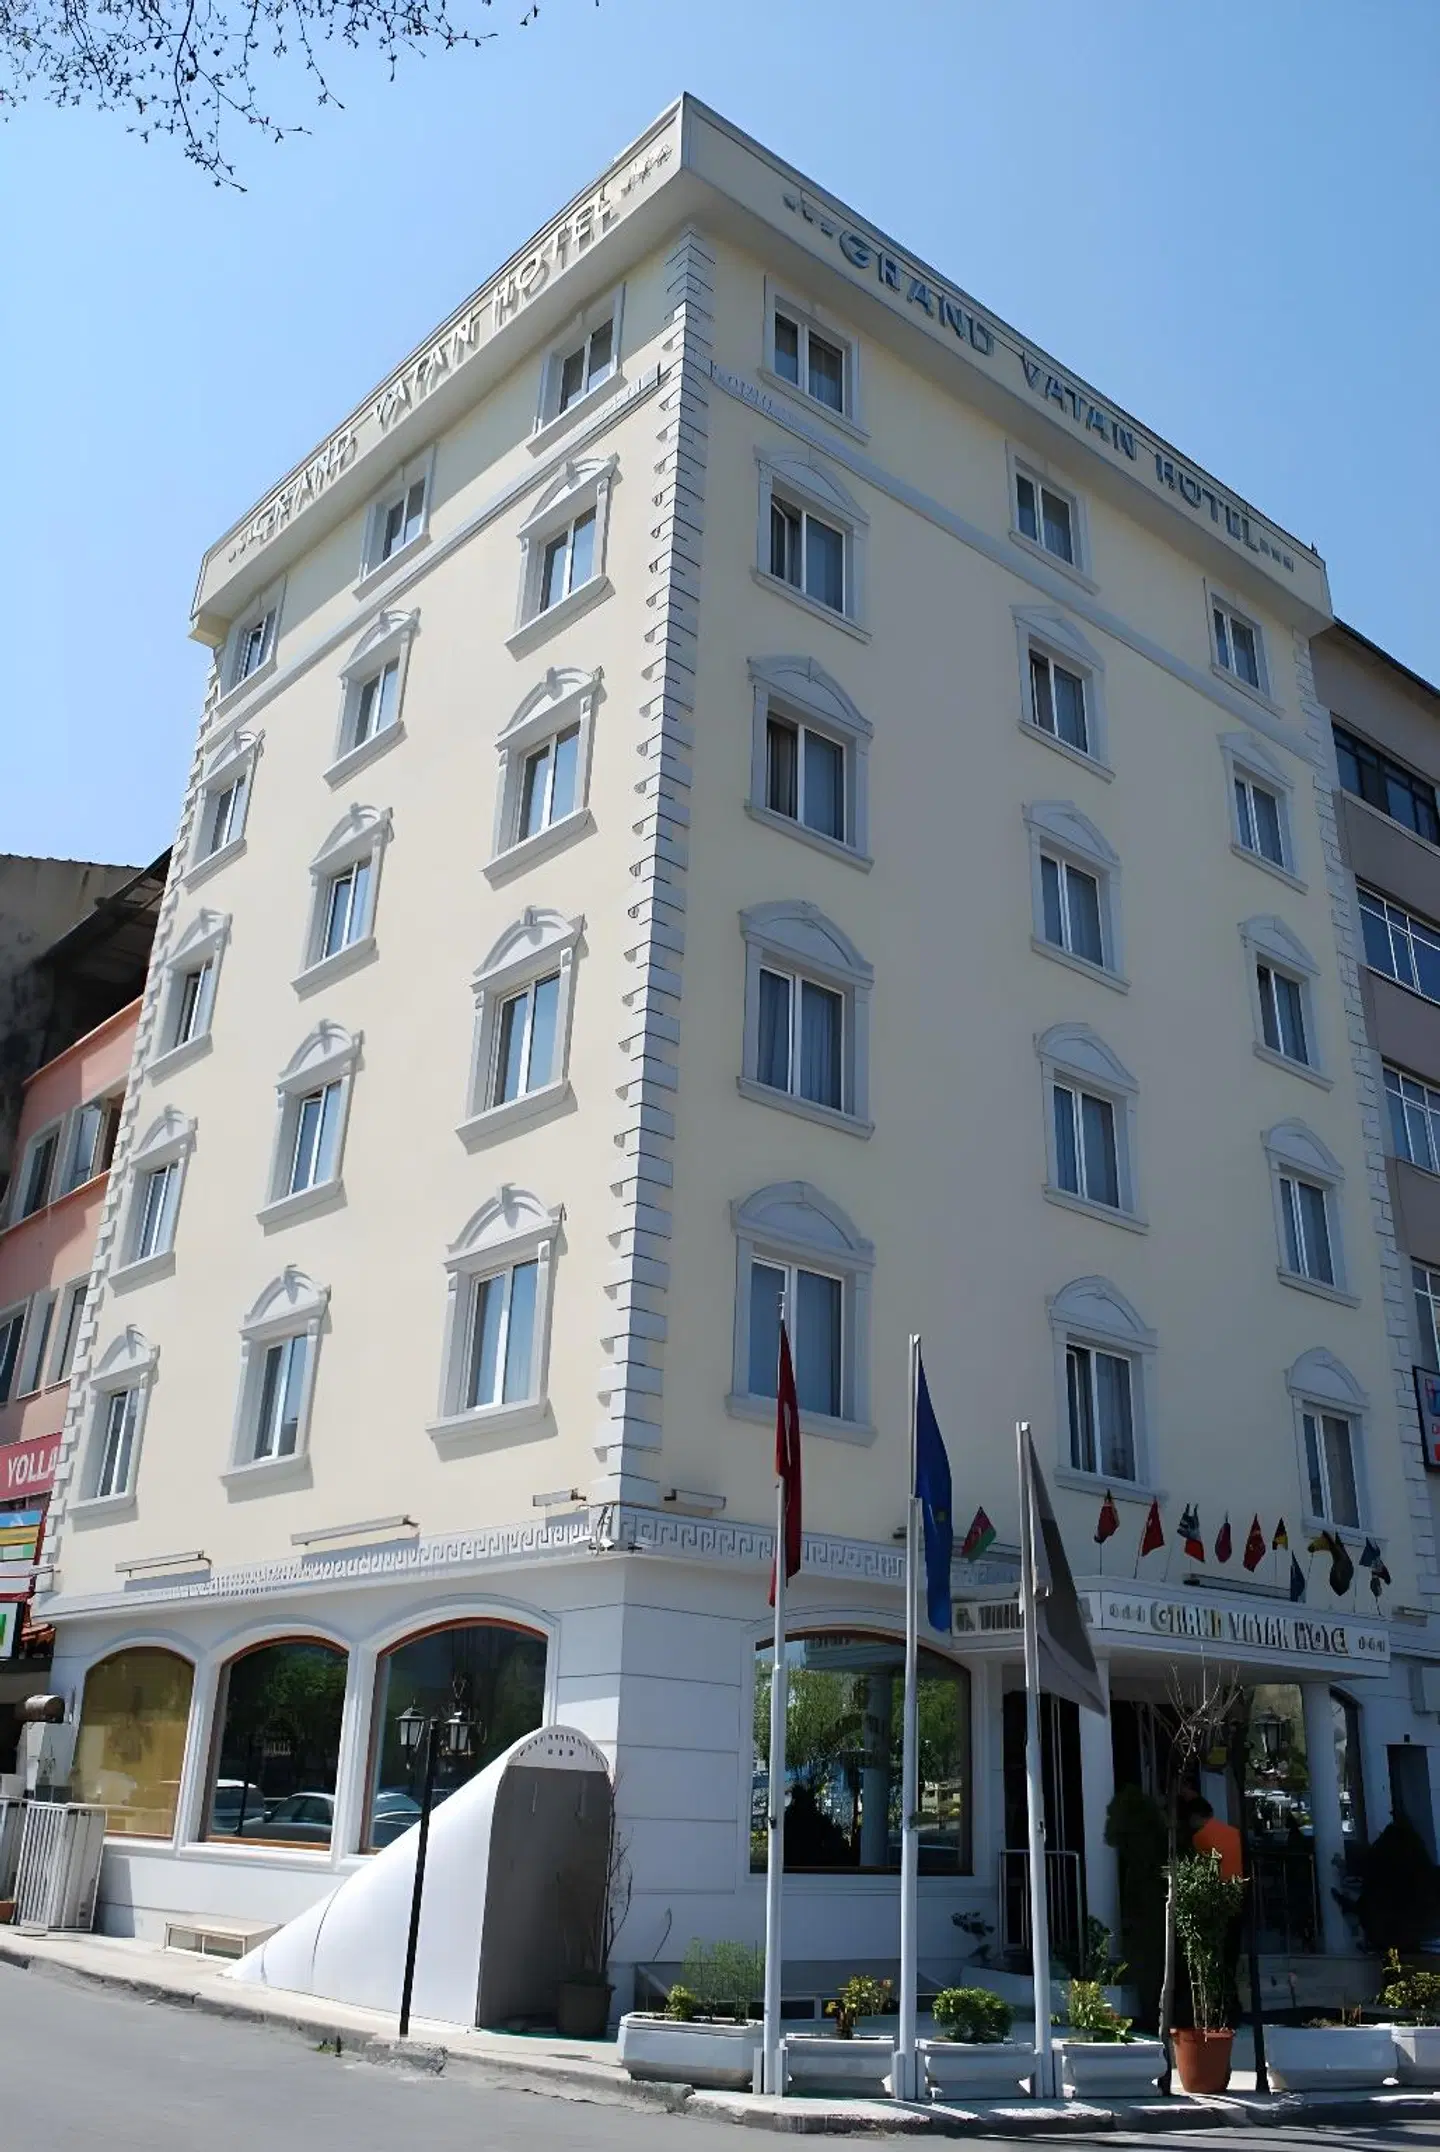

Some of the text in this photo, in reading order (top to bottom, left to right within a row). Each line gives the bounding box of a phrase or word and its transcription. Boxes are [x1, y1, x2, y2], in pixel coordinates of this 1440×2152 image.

[491, 186, 614, 320] HOTEL
[838, 230, 995, 356] GRAND
[1021, 352, 1138, 461] VATAN
